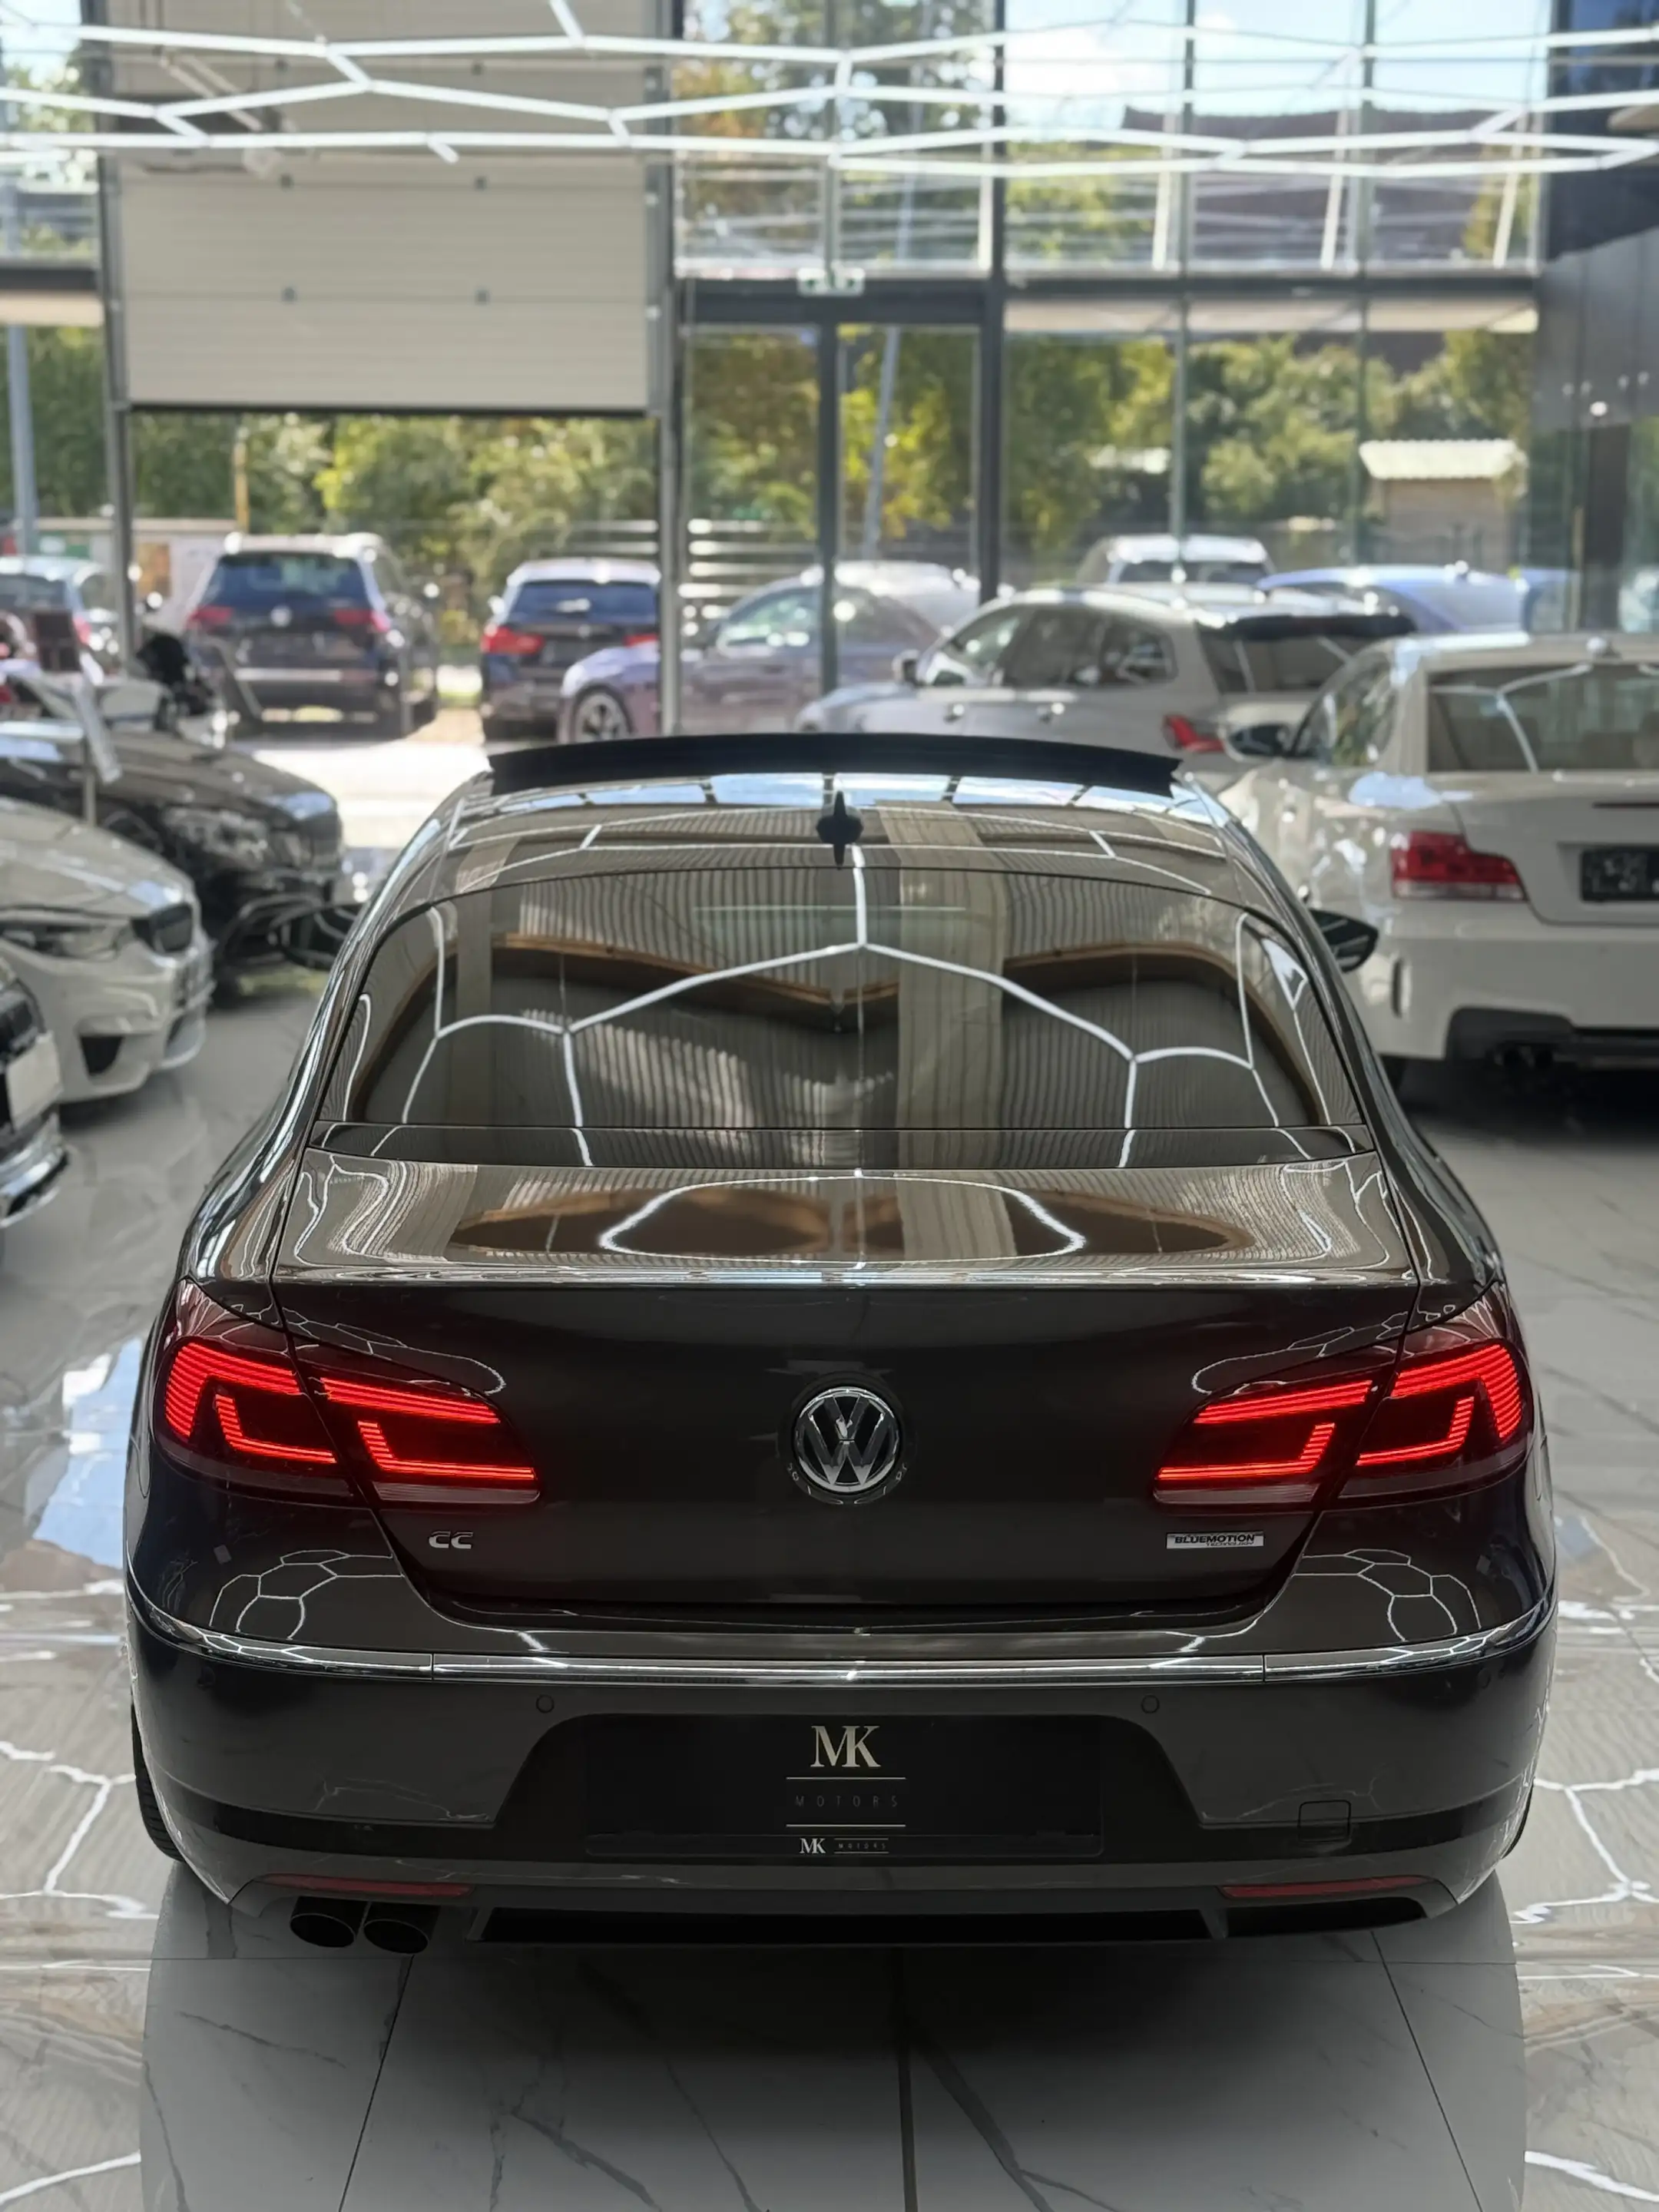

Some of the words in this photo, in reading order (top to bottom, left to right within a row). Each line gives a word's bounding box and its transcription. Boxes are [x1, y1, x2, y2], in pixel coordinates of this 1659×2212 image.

[429, 1531, 473, 1549] CC
[1174, 1534, 1255, 1544] BLUEMOTION
[810, 1725, 881, 1767] MK
[795, 1795, 898, 1807] MOTORS
[800, 1837, 826, 1853] MK
